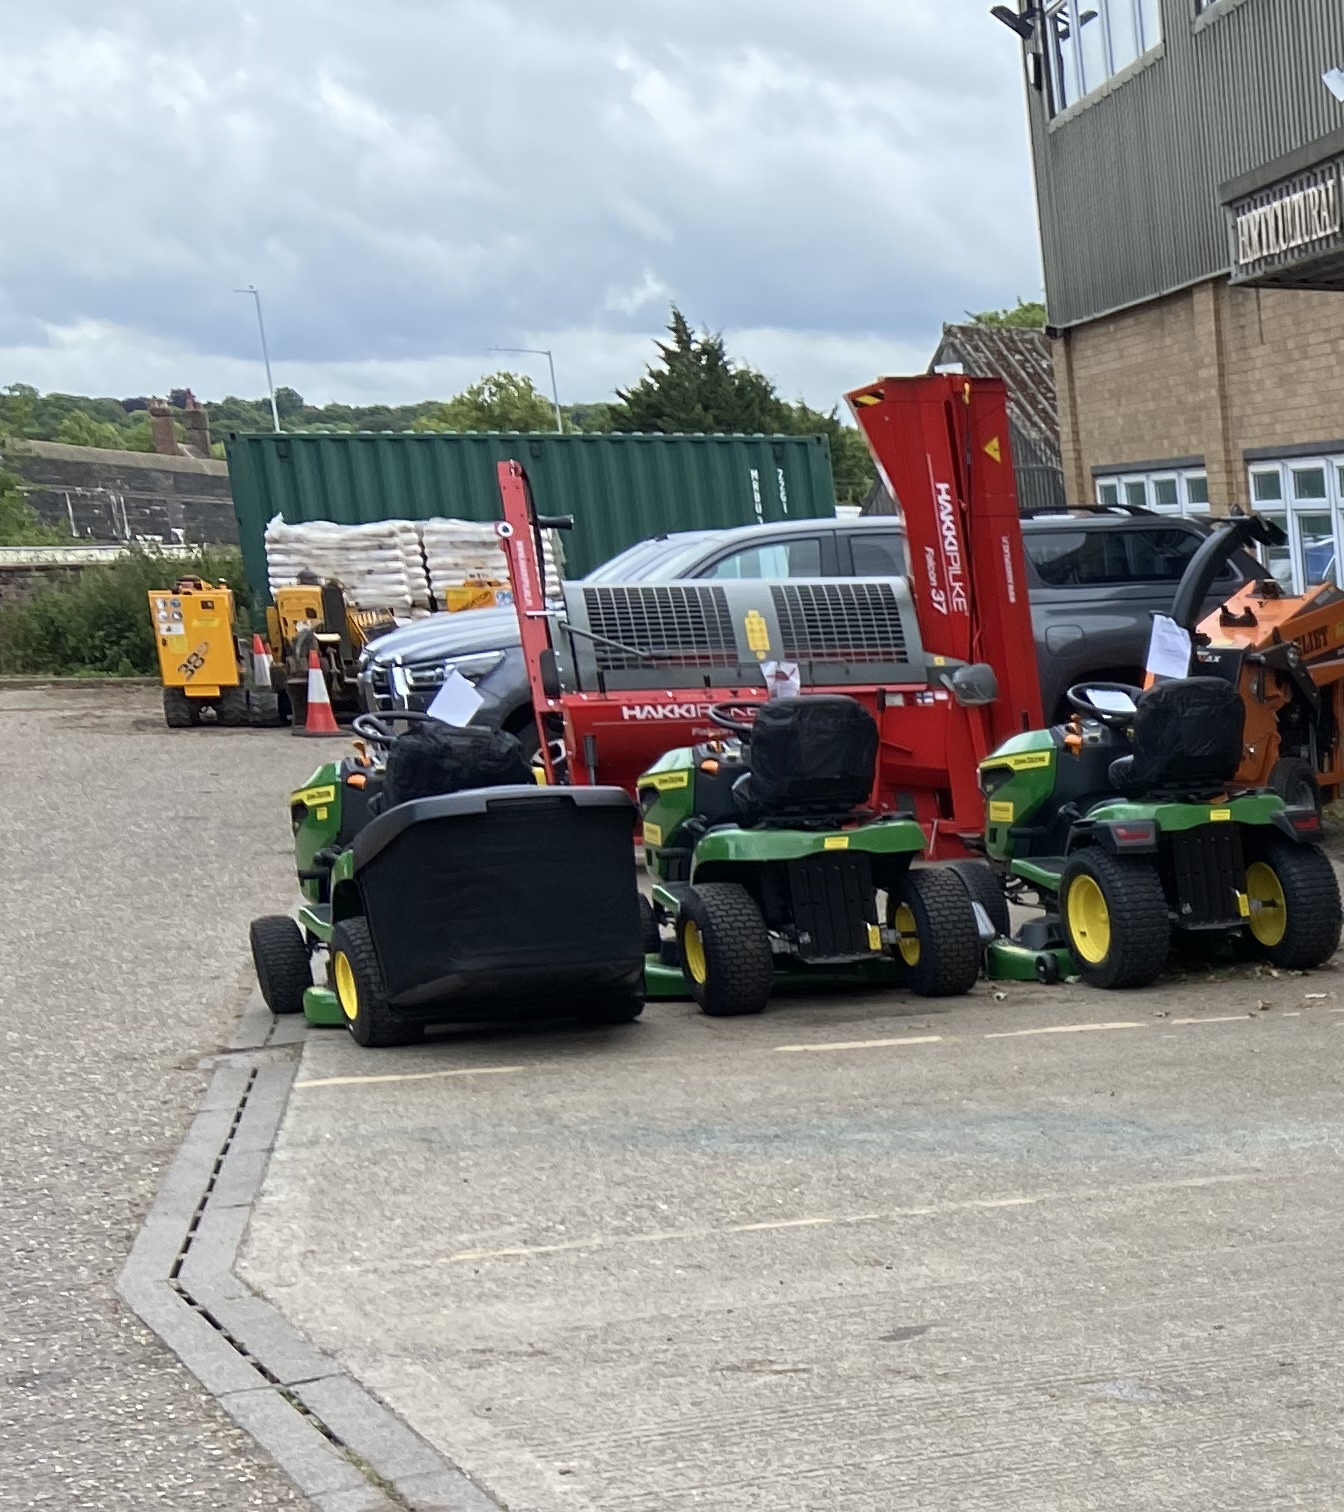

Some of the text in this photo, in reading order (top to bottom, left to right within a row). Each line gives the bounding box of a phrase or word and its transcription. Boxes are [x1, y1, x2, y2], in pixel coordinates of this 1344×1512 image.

[925, 546, 948, 615] Falcon 37
[936, 483, 966, 612] HAKKIPILKE
